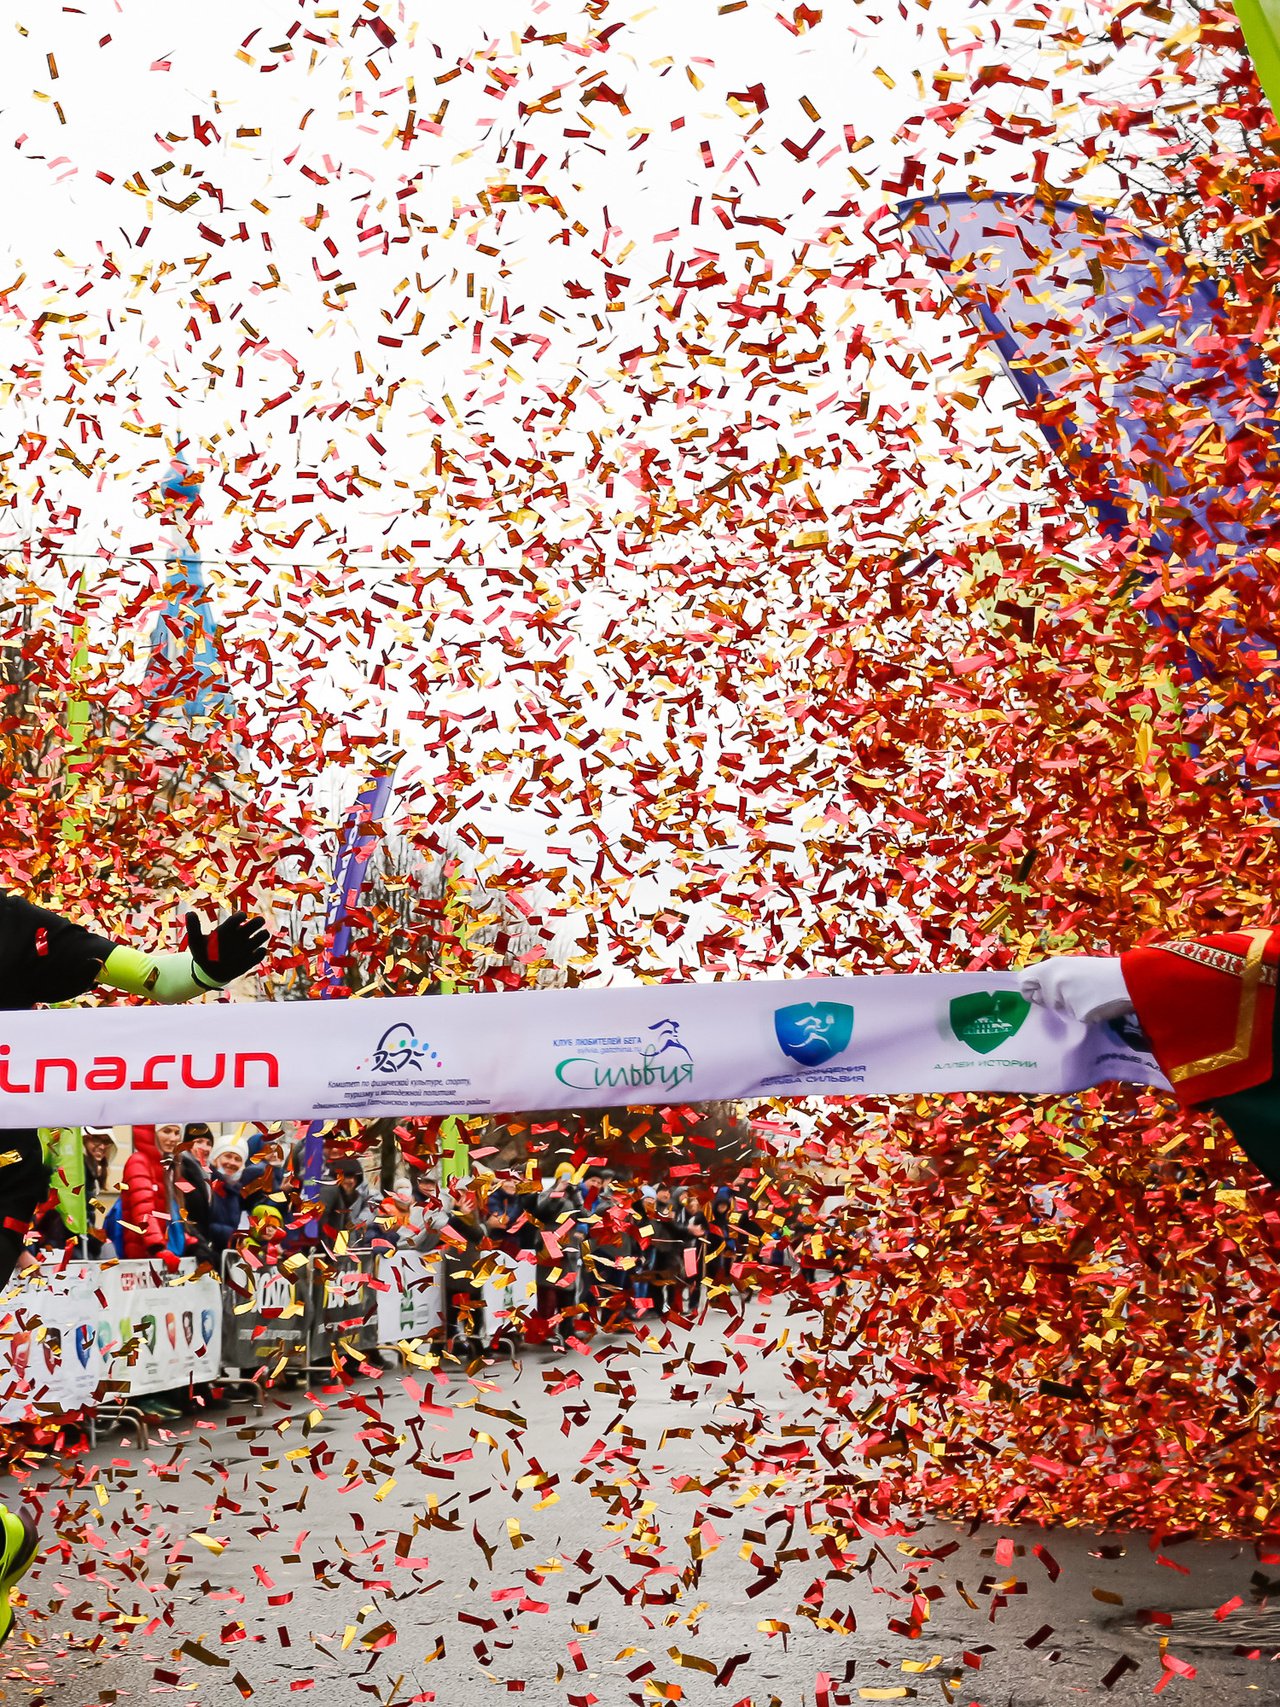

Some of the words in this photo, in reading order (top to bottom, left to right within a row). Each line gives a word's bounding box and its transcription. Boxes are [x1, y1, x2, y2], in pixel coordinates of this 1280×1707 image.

[553, 1039, 573, 1047] КЛУБ
[575, 1036, 621, 1046] ЛЮБИТЕЛЕЙ
[623, 1036, 642, 1045] БЕГА
[555, 1044, 694, 1092] Сильвия
[933, 1060, 974, 1070] АЛЛЕИ
[978, 1058, 1038, 1069] ИСТОРИИ
[327, 1081, 360, 1089] Комитет
[371, 1079, 409, 1088] физической
[806, 1075, 864, 1083] СИЛЬВИЯ
[344, 1091, 374, 1099] туризму
[367, 1099, 408, 1107] Гатчинского
